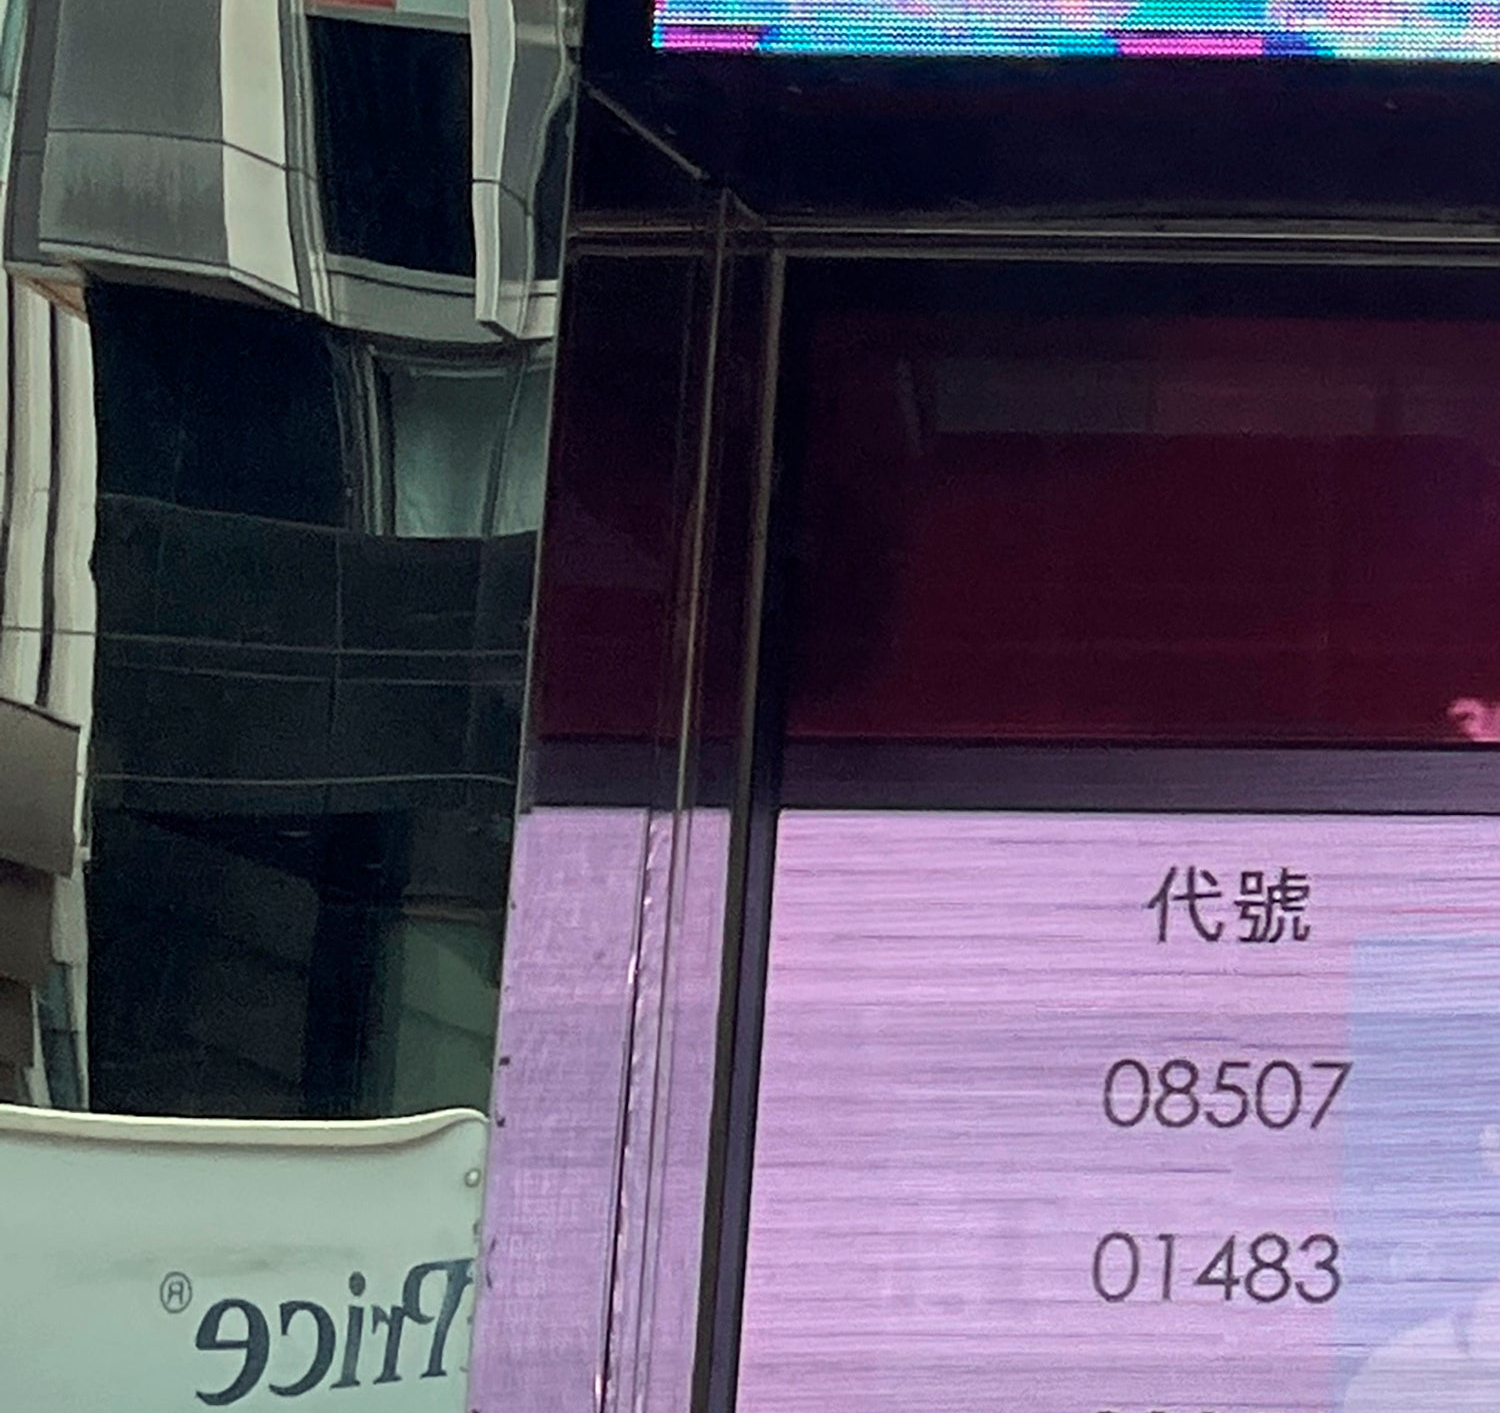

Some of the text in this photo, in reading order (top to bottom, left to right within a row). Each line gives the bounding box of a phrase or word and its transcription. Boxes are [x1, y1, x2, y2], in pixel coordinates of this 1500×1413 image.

[1146, 866, 1311, 944] 代號
[1103, 1058, 1352, 1130] 08507
[1092, 1232, 1341, 1304] 01483
